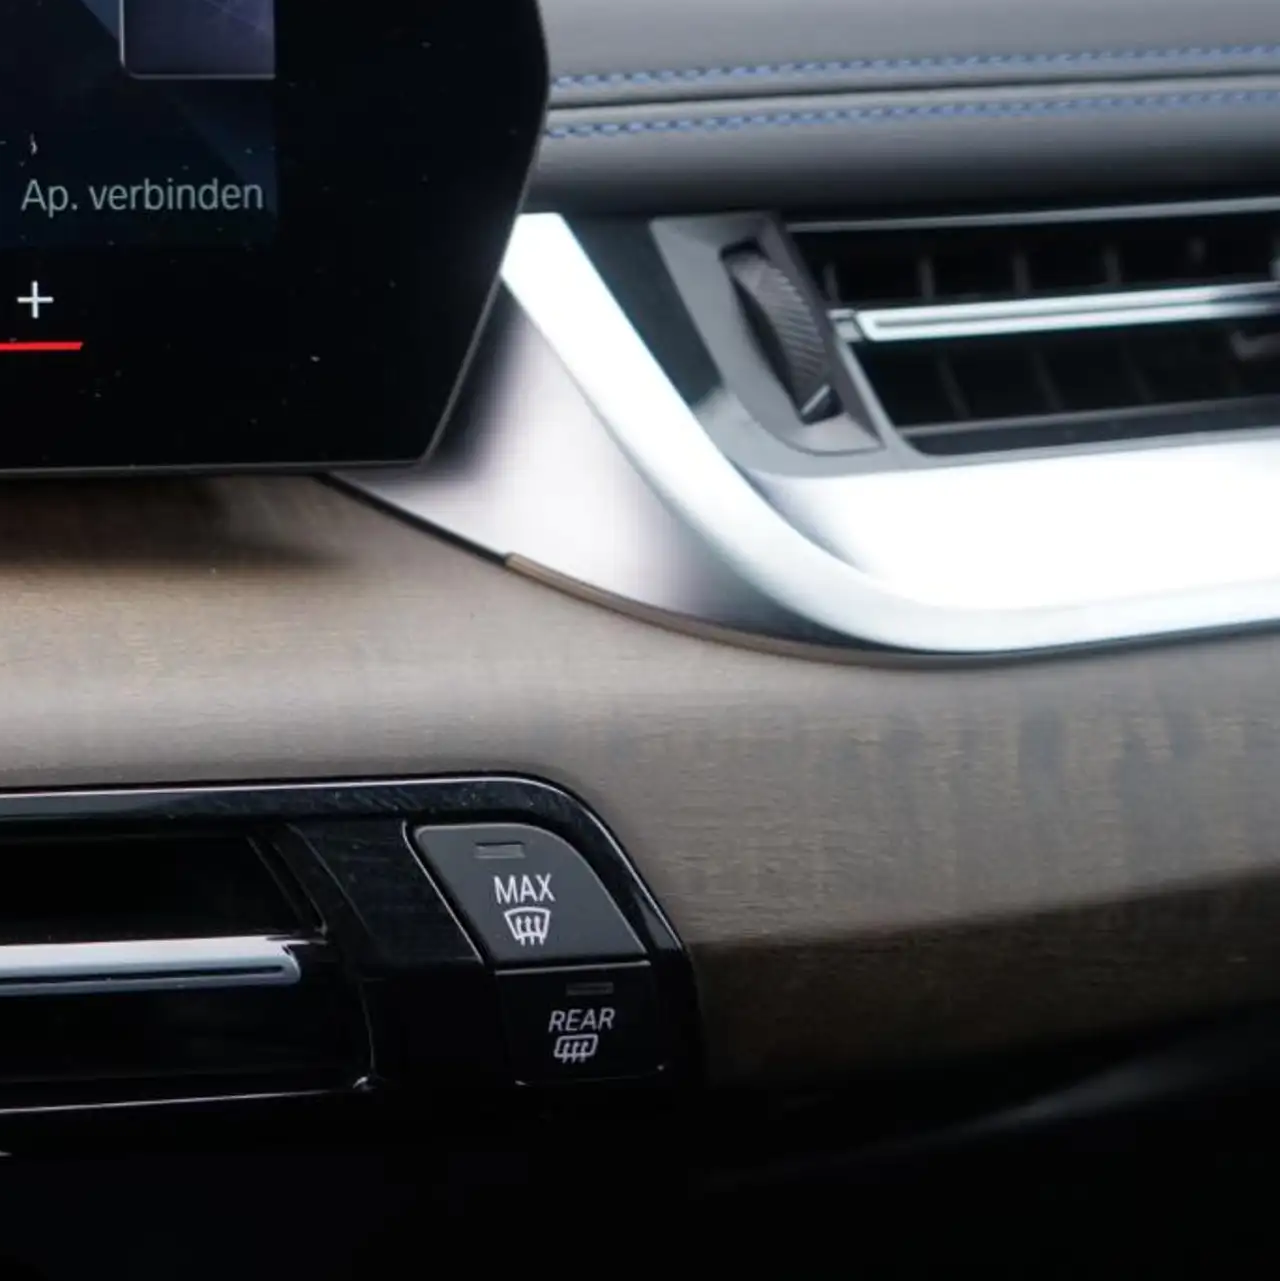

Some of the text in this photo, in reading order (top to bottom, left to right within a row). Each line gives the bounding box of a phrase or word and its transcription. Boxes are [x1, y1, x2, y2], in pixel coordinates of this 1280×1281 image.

[21, 179, 265, 217] Ap. verbinden
[493, 873, 556, 904] MAX
[548, 1007, 615, 1032] REAR
